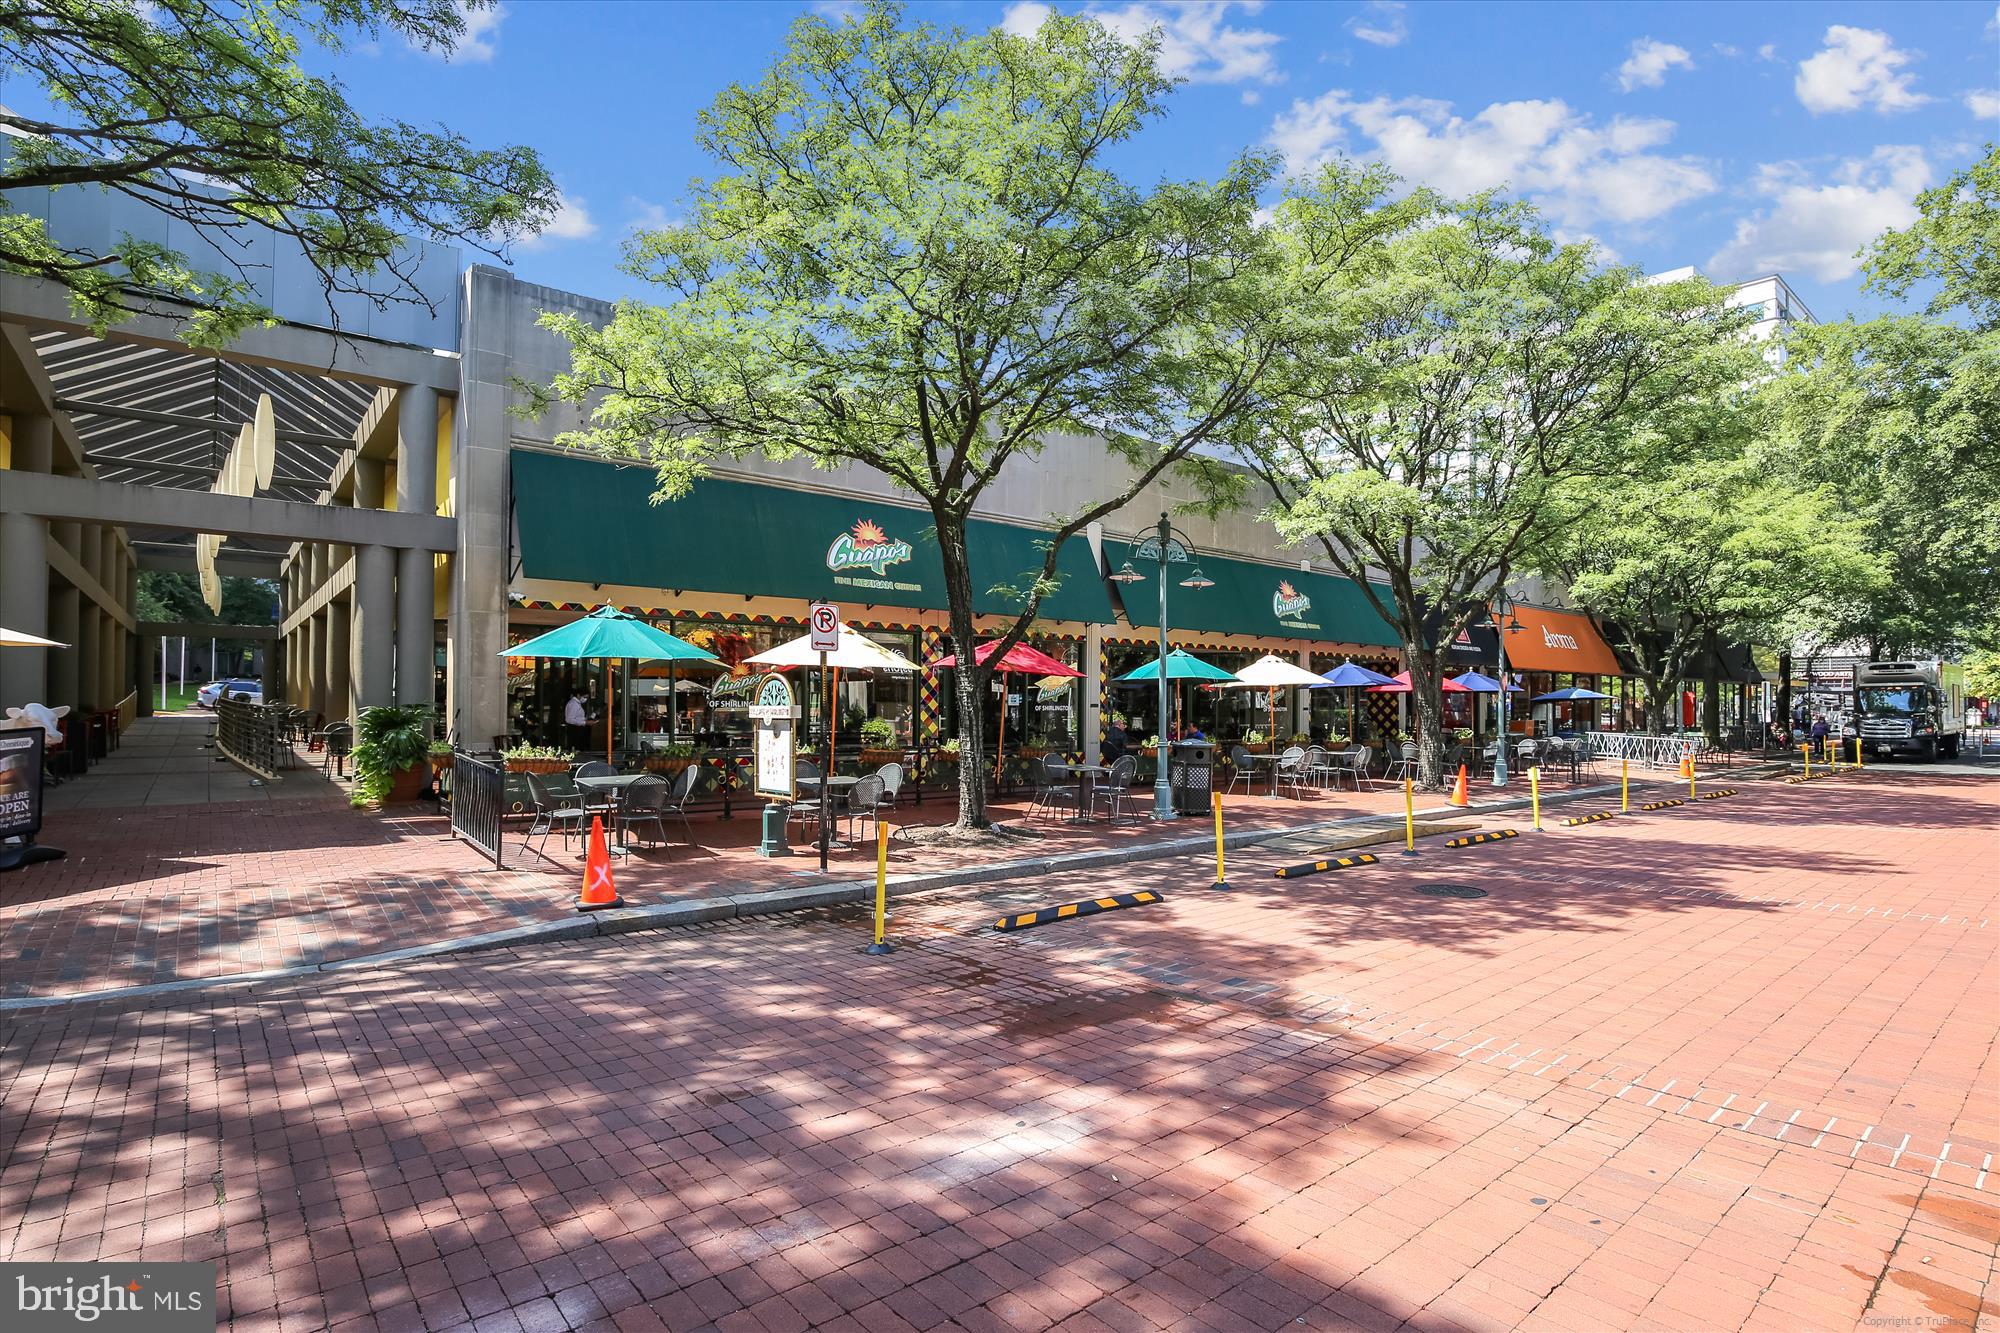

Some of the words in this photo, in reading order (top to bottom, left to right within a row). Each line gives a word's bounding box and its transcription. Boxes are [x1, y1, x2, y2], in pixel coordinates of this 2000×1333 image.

[828, 534, 909, 573] Guapo's
[853, 578, 894, 590] MEXICAN
[820, 611, 832, 628] P
[1541, 624, 1578, 650] Aroma
[712, 673, 762, 696] Guapo's
[12, 791, 30, 800] ARE
